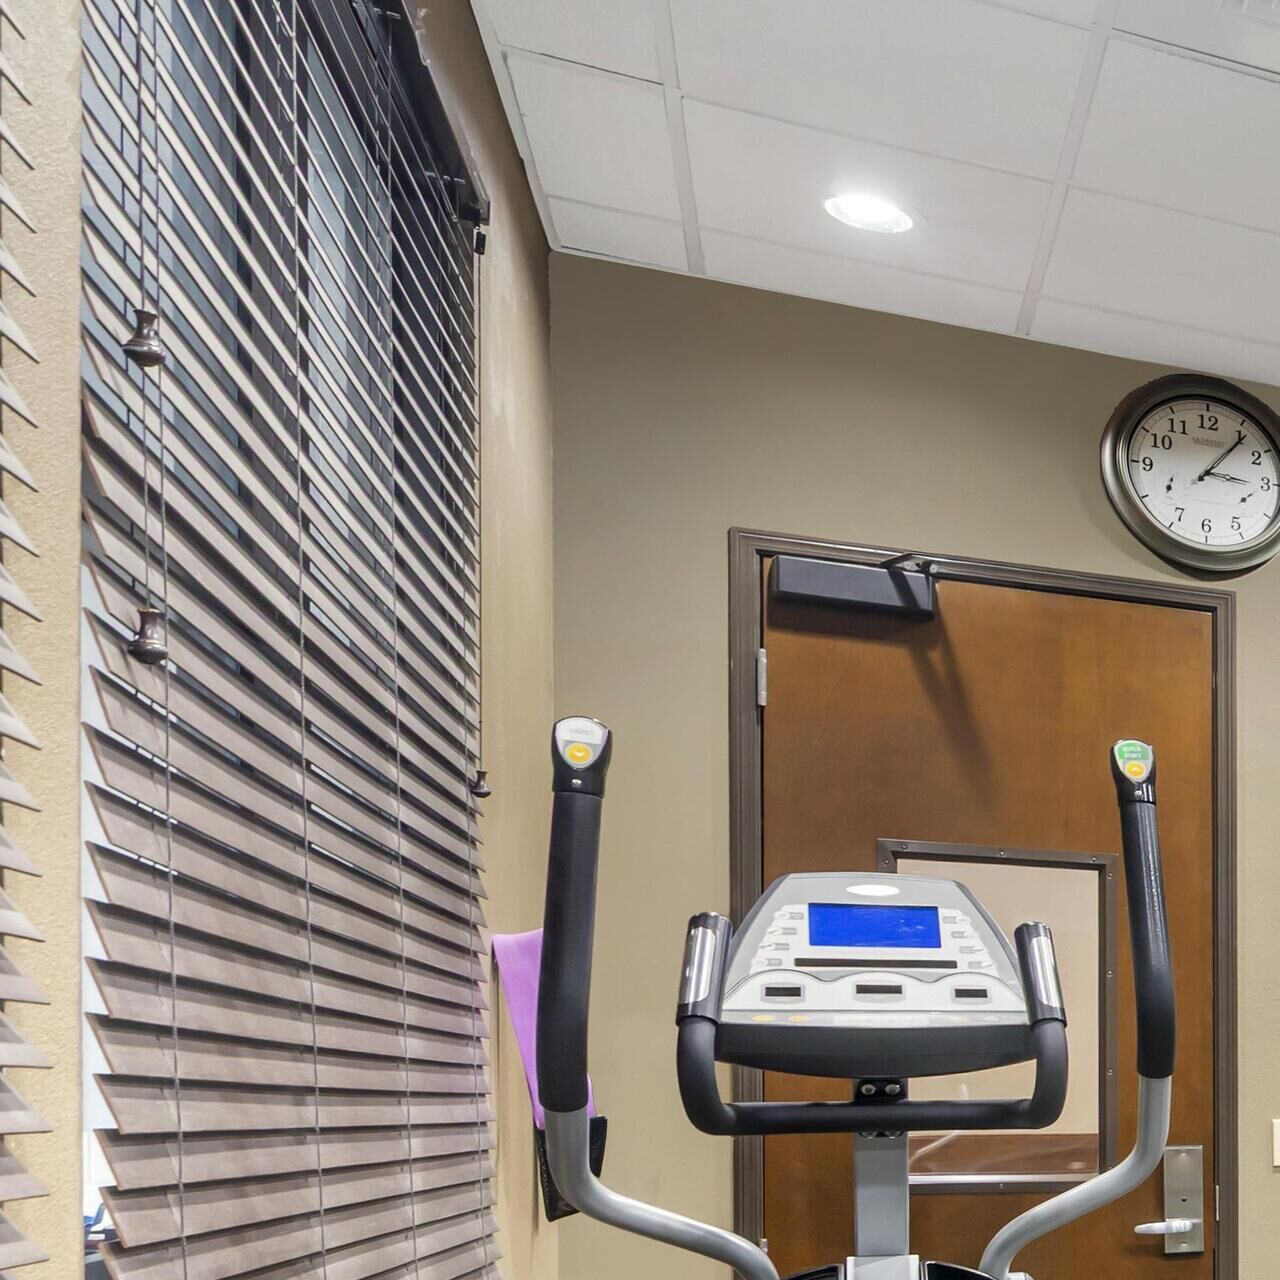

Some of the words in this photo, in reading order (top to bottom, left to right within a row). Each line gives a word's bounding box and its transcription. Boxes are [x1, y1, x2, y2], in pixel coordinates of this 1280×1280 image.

[1168, 418, 1189, 435] 11
[1197, 414, 1219, 431] 12
[1151, 433, 1173, 450] 10
[1142, 456, 1153, 472] 9
[1251, 450, 1262, 466] 2
[1260, 477, 1271, 492] 3
[1174, 507, 1185, 522] 7
[1201, 519, 1212, 533] 6
[1230, 516, 1241, 531] 5
